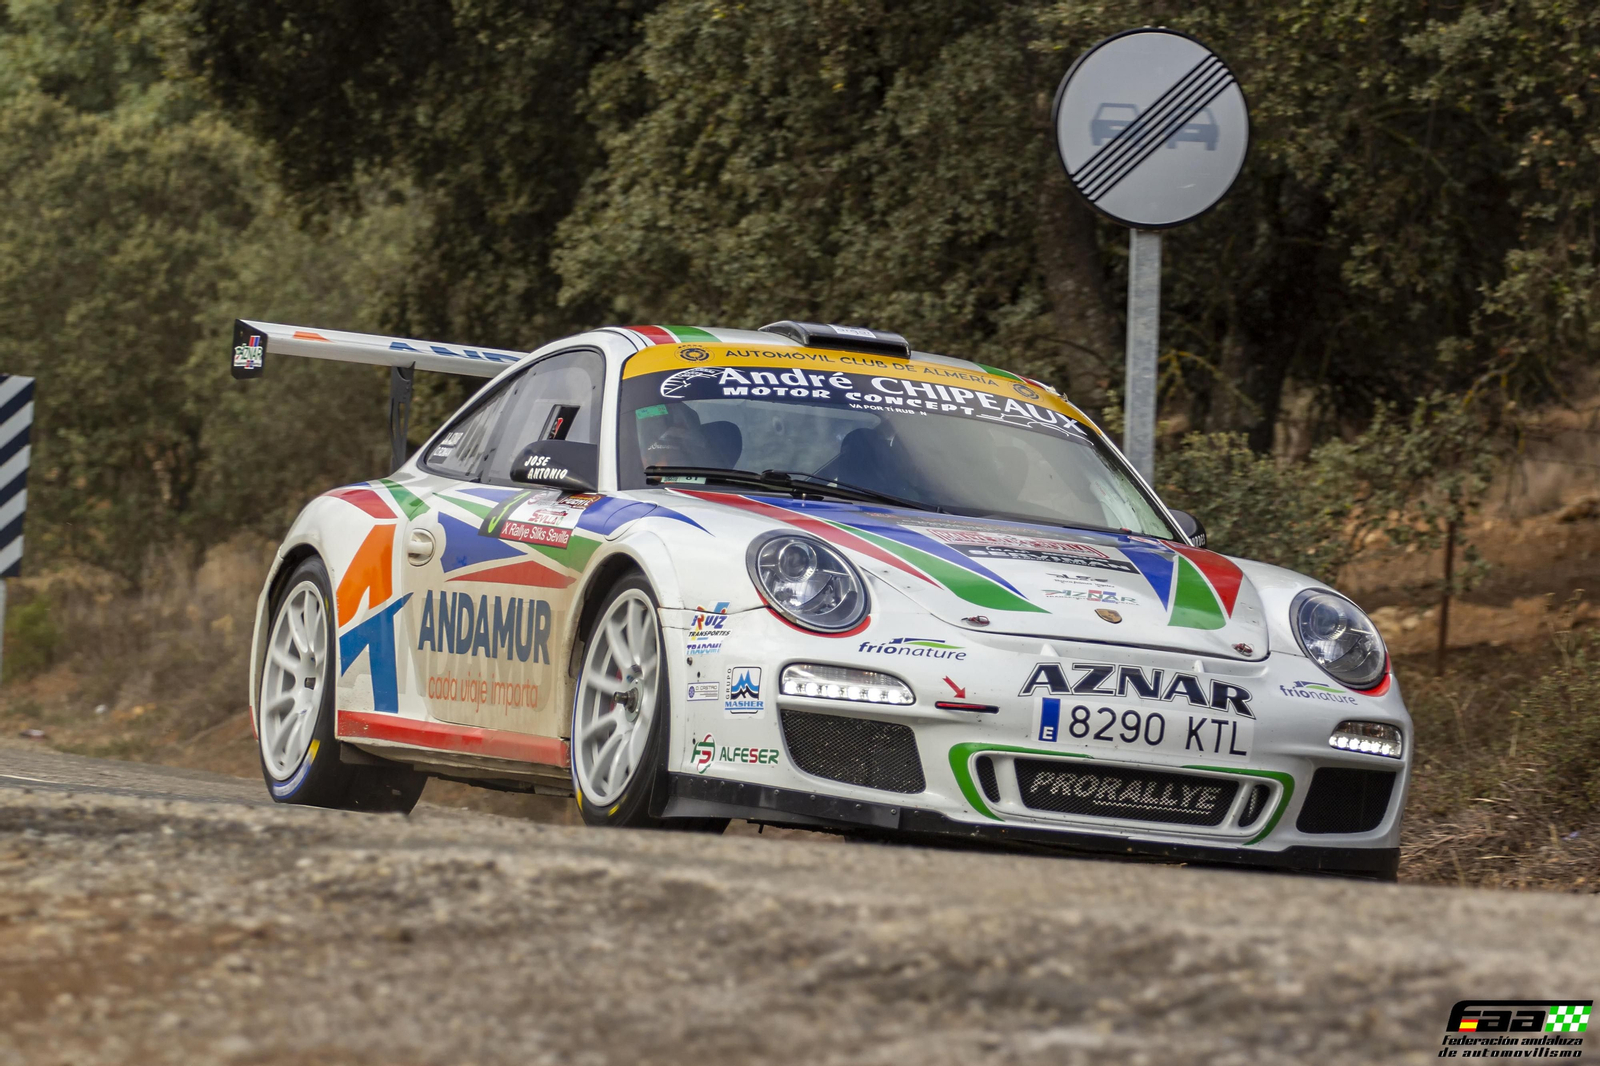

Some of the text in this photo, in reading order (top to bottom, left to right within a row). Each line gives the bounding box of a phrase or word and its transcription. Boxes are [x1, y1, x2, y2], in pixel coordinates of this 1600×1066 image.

[726, 350, 999, 387] AUTOMÓVIL CLUB DE ALMERÍA
[719, 368, 1088, 436] André CHIPEAUX
[723, 386, 975, 415] MOTOR CONCEPT
[524, 455, 551, 467] JOSE
[527, 468, 568, 480] ANTONIO
[501, 523, 509, 534] X
[509, 524, 530, 540] Rallye
[546, 529, 570, 544] Sevilla
[418, 590, 551, 665] ANDAMUR
[691, 613, 728, 630] RUIZ
[428, 671, 458, 701] cada
[490, 673, 539, 716] importa
[1018, 663, 1256, 720] AZNAR
[1043, 727, 1053, 739] E
[1069, 705, 1247, 756] 8290 KTL
[719, 746, 780, 764] ALFESER
[1030, 771, 1222, 810] PRORALLYE
